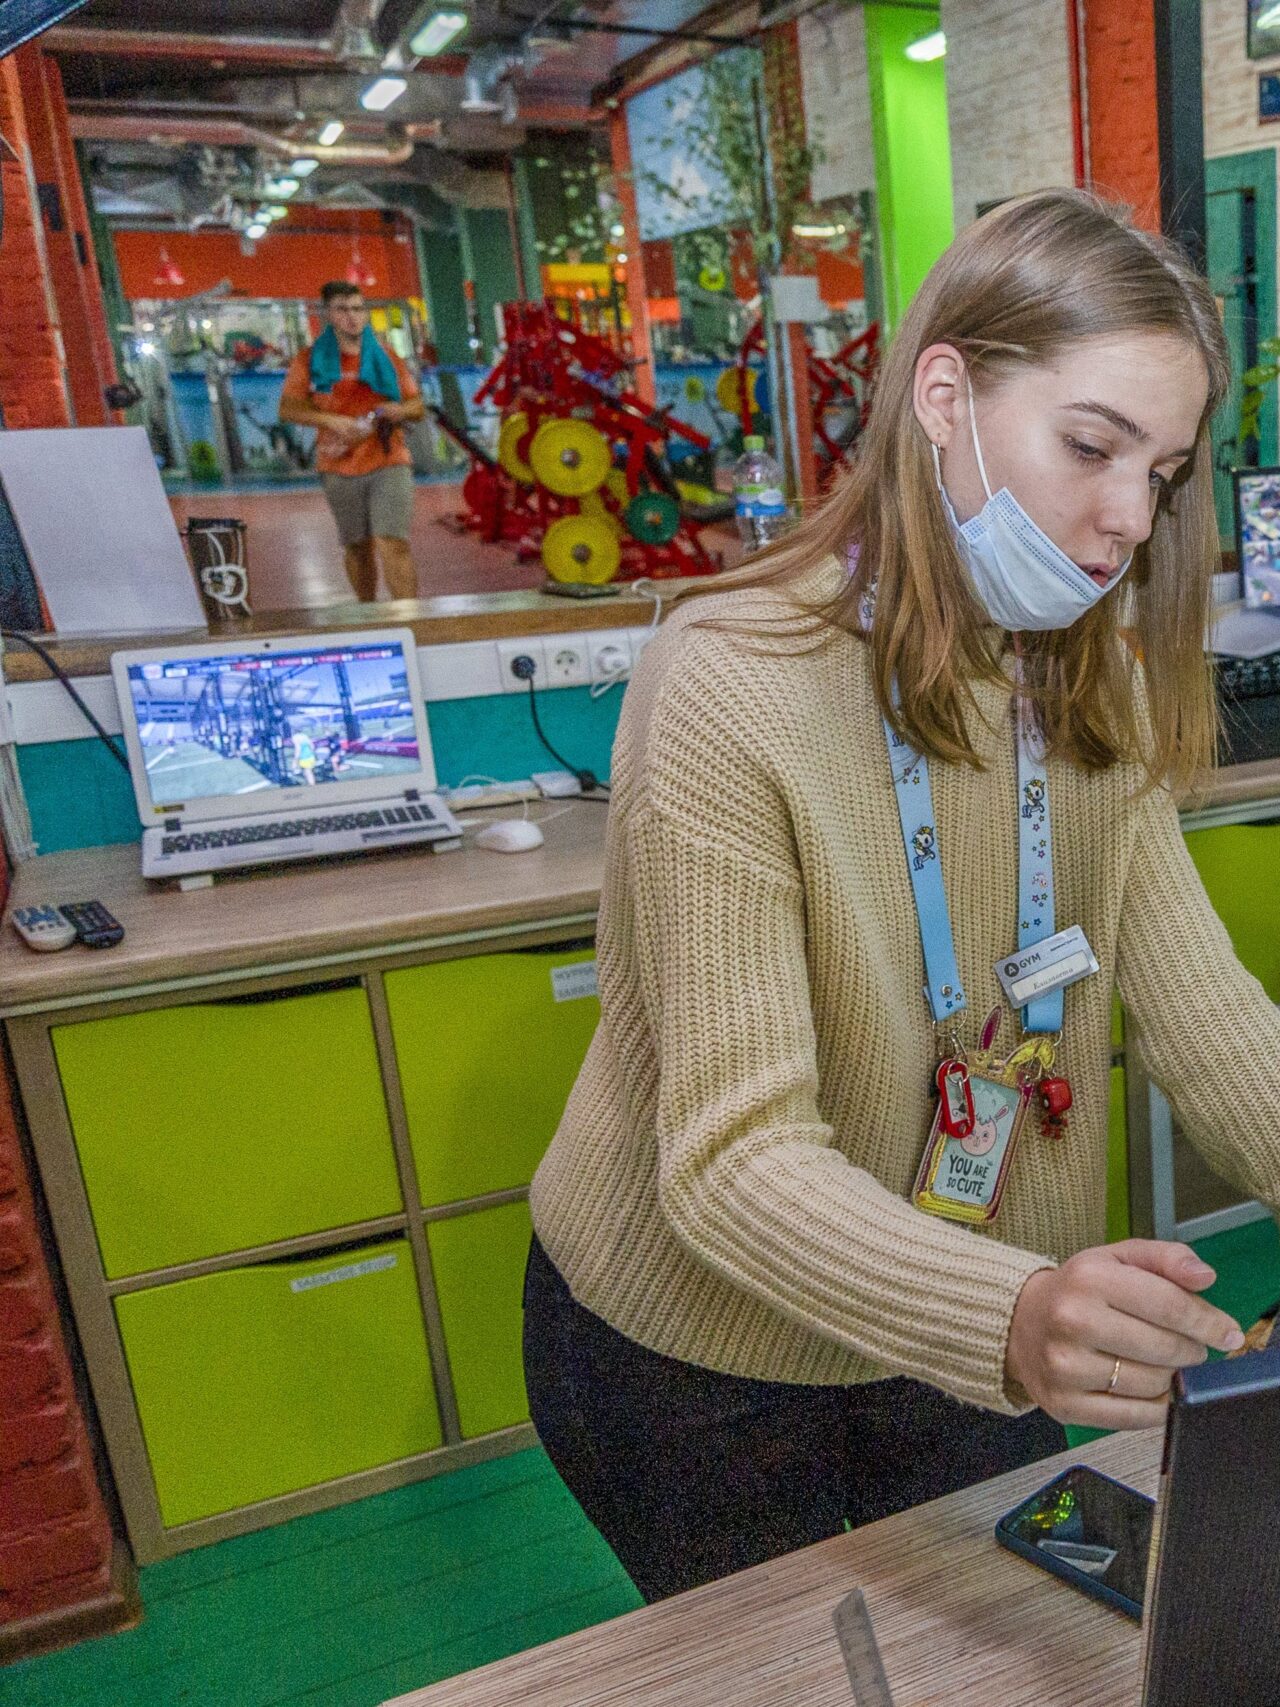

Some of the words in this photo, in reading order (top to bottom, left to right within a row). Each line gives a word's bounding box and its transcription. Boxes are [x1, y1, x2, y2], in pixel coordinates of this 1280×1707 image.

[1020, 953, 1041, 968] GYM
[950, 1154, 973, 1176] YOU
[972, 1164, 989, 1179] ARE
[946, 1177, 956, 1188] SO
[957, 1178, 985, 1197] CUTE
